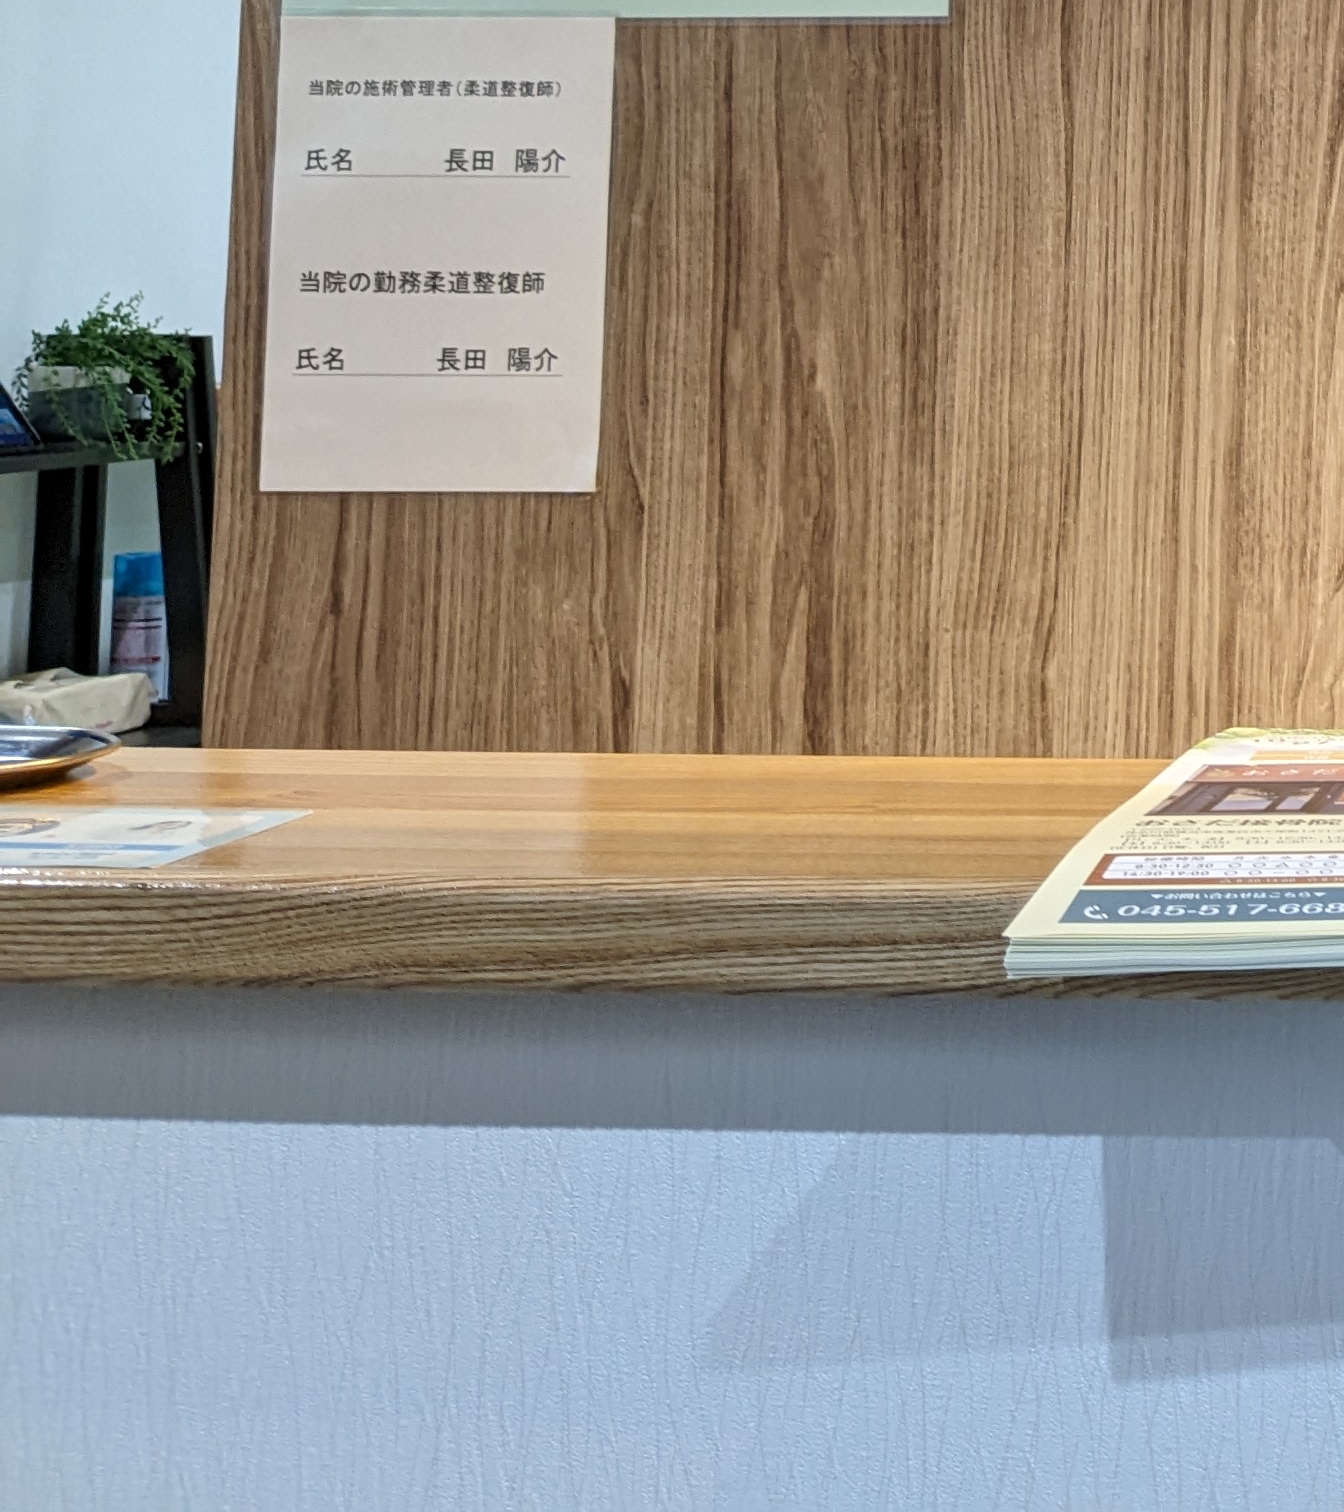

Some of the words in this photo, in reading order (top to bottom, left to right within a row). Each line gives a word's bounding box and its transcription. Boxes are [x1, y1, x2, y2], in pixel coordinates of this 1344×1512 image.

[304, 149, 353, 172] 氏名
[445, 149, 494, 172] 長田
[515, 149, 566, 172] 陽介
[299, 271, 545, 295] 当院の勤務柔道整復師
[295, 348, 345, 371] 氏名
[436, 348, 486, 371] 長田
[507, 348, 558, 371] 陽介
